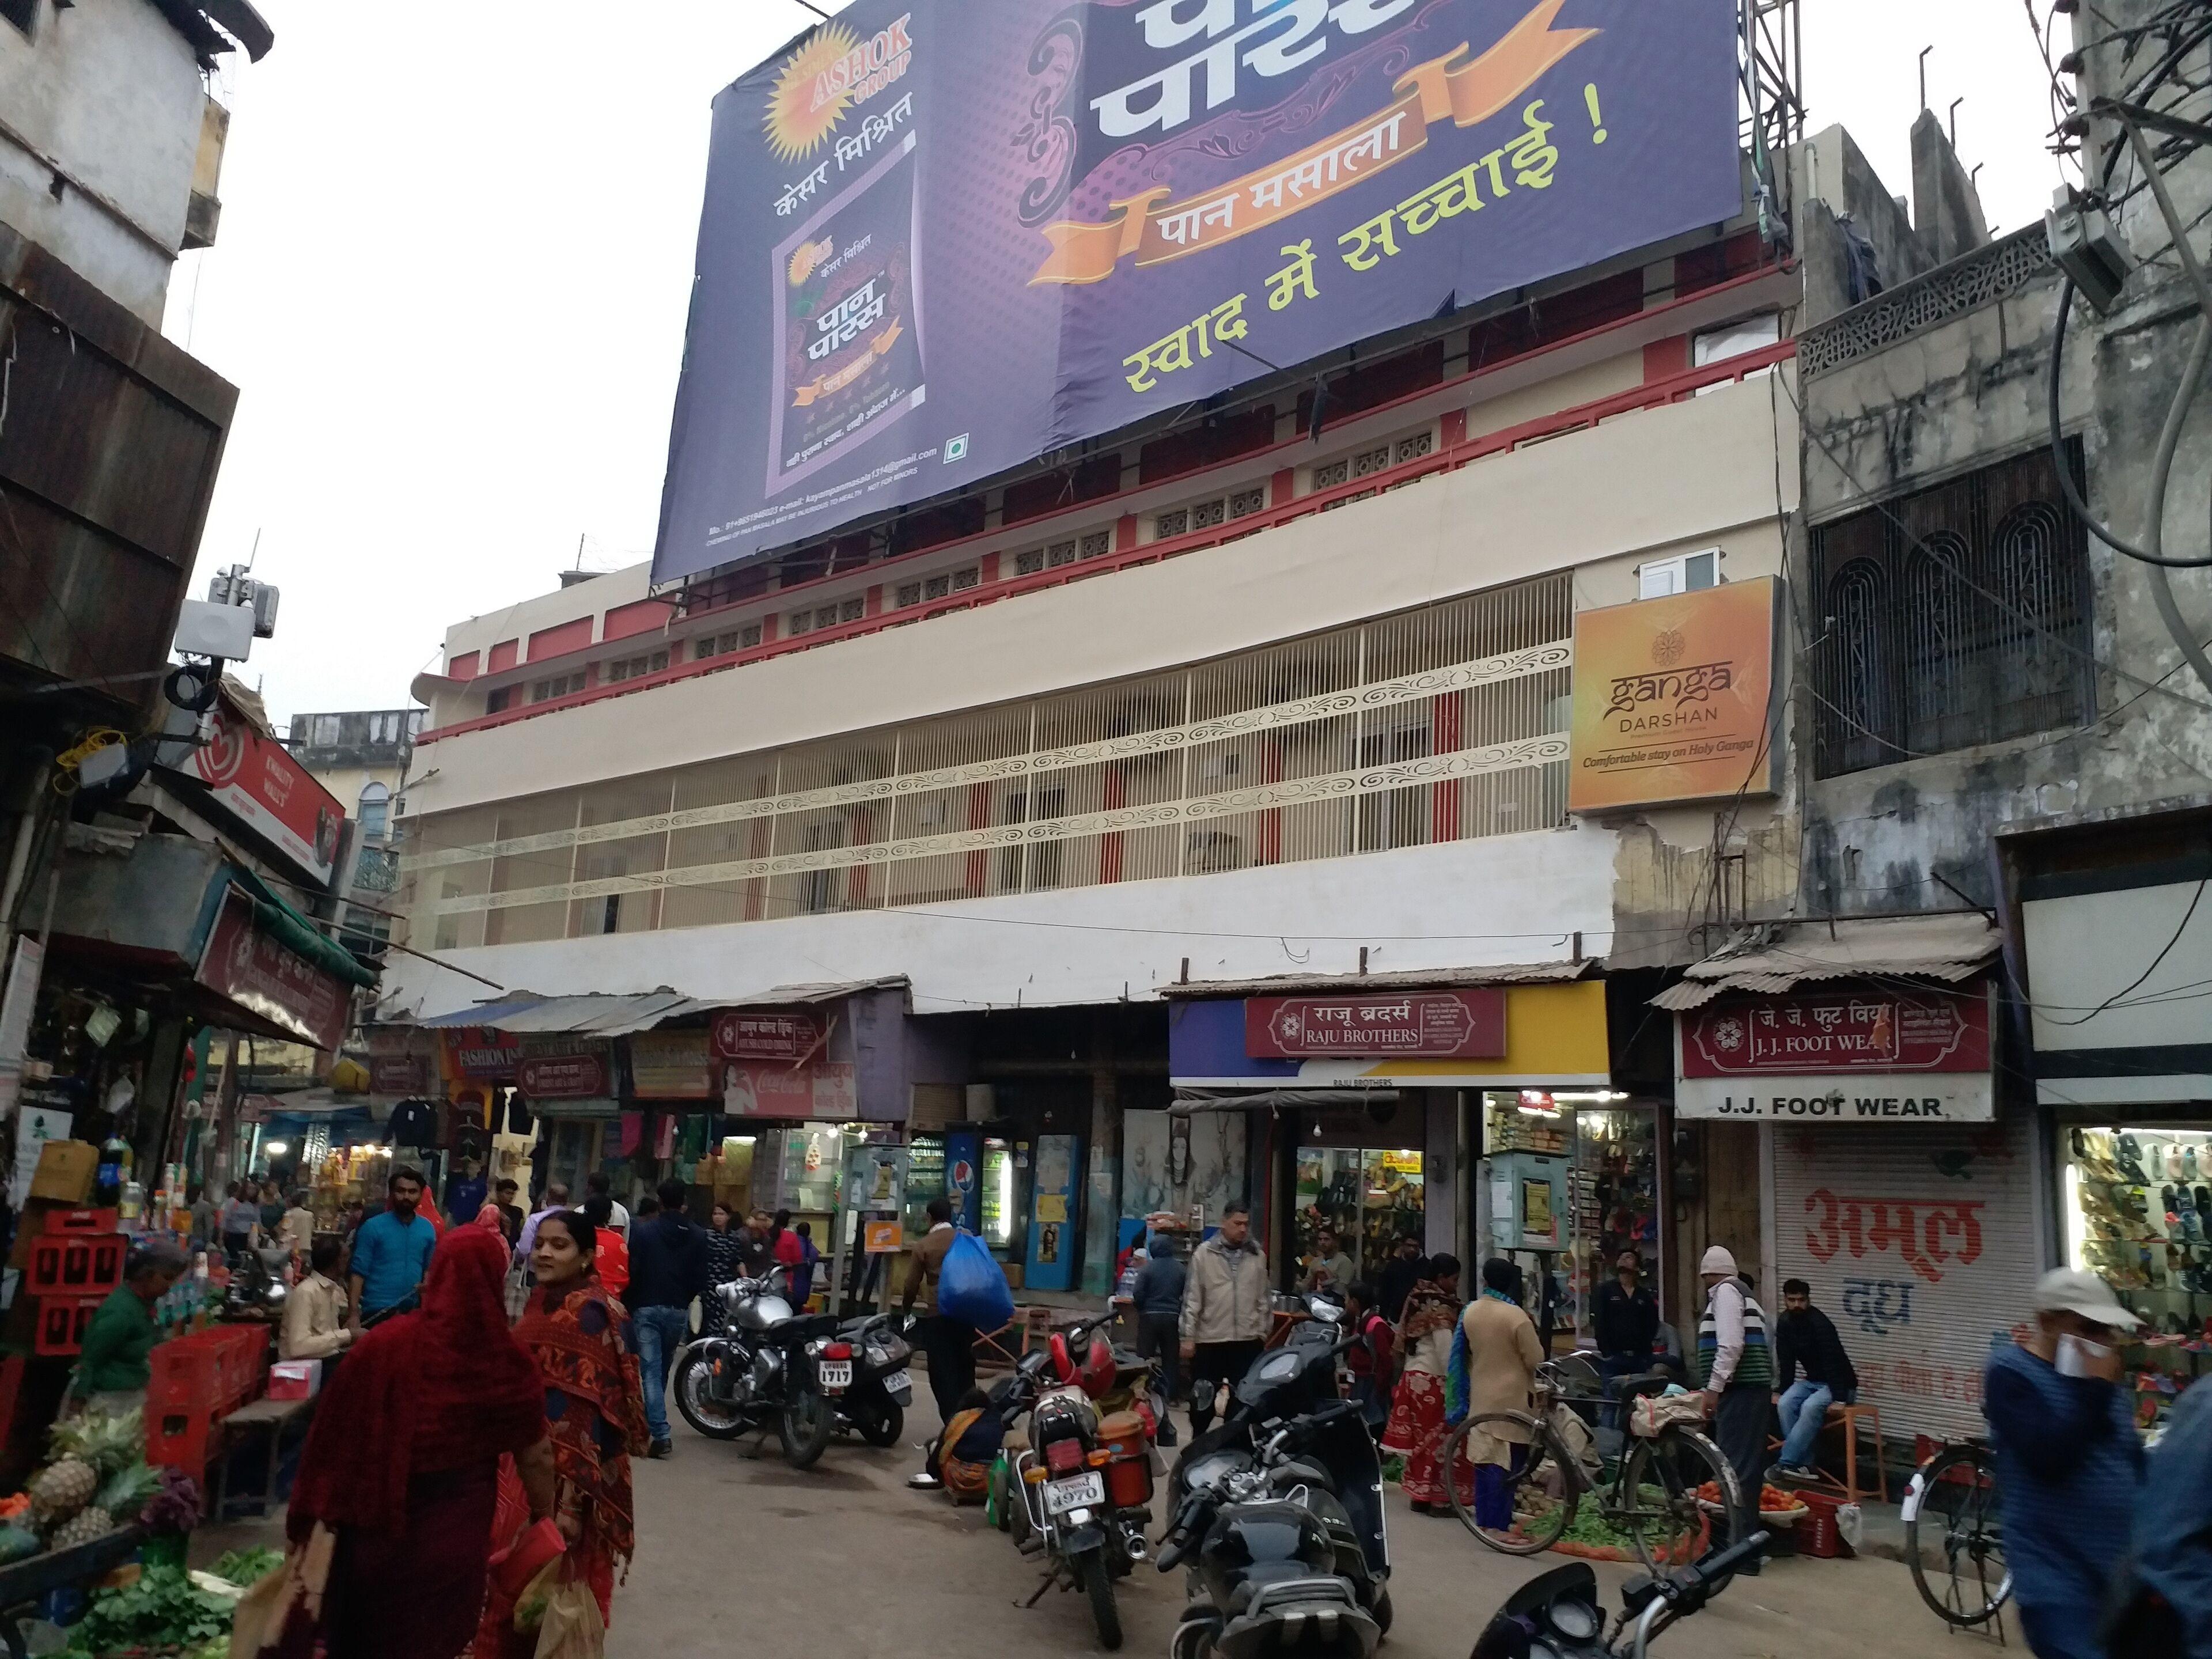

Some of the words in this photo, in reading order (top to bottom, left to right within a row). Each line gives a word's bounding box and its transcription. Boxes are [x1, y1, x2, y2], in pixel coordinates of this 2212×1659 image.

[810, 12, 912, 112] ASHOK
[855, 50, 911, 104] GROUP
[773, 160, 829, 216] केसर
[834, 91, 913, 171] मिश्रित
[1158, 193, 1241, 246] पान
[1249, 111, 1407, 210] मसाला
[820, 257, 842, 278] केसर
[844, 234, 872, 263] मिश्रित
[1122, 293, 1248, 393] स्वाद
[1264, 239, 1320, 312] में
[1338, 99, 1560, 271] सच्चाई
[1584, 83, 1609, 145] !
[817, 278, 876, 332] पान
[808, 293, 885, 360] पारस
[823, 378, 840, 392] पान
[844, 351, 873, 380] मसाला
[839, 489, 862, 503] HEALTH
[867, 482, 880, 491] NOT
[881, 477, 893, 486] FOR
[893, 467, 918, 481] MINORS
[1603, 661, 1733, 721] ganga
[1620, 707, 1717, 733] DARSHAN
[1583, 749, 1646, 768] Comfortable
[1647, 749, 1671, 762] stay
[1672, 748, 1687, 756] on
[1688, 743, 1715, 756] Holy
[1716, 739, 1754, 754] Ganga
[1312, 1007, 1356, 1026] राजू
[1358, 1000, 1411, 1022] ब्रदर्स
[1812, 1006, 1843, 1032] फुट
[459, 1048, 505, 1067] FASHION
[1306, 1029, 1340, 1045] RAJU
[1343, 1029, 1418, 1043] BROTHERS
[1756, 1038, 1767, 1056] J.
[1771, 1037, 1782, 1055] J.
[1786, 1036, 1834, 1052] FOOT
[1718, 1097, 1762, 1114] J.J.
[1772, 1098, 1846, 1116] FOOT
[1855, 1098, 1941, 1116] WEAR
[1805, 1188, 1986, 1283] अमूल
[1843, 1279, 1914, 1335] दूध
[823, 1370, 849, 1382] 1717
